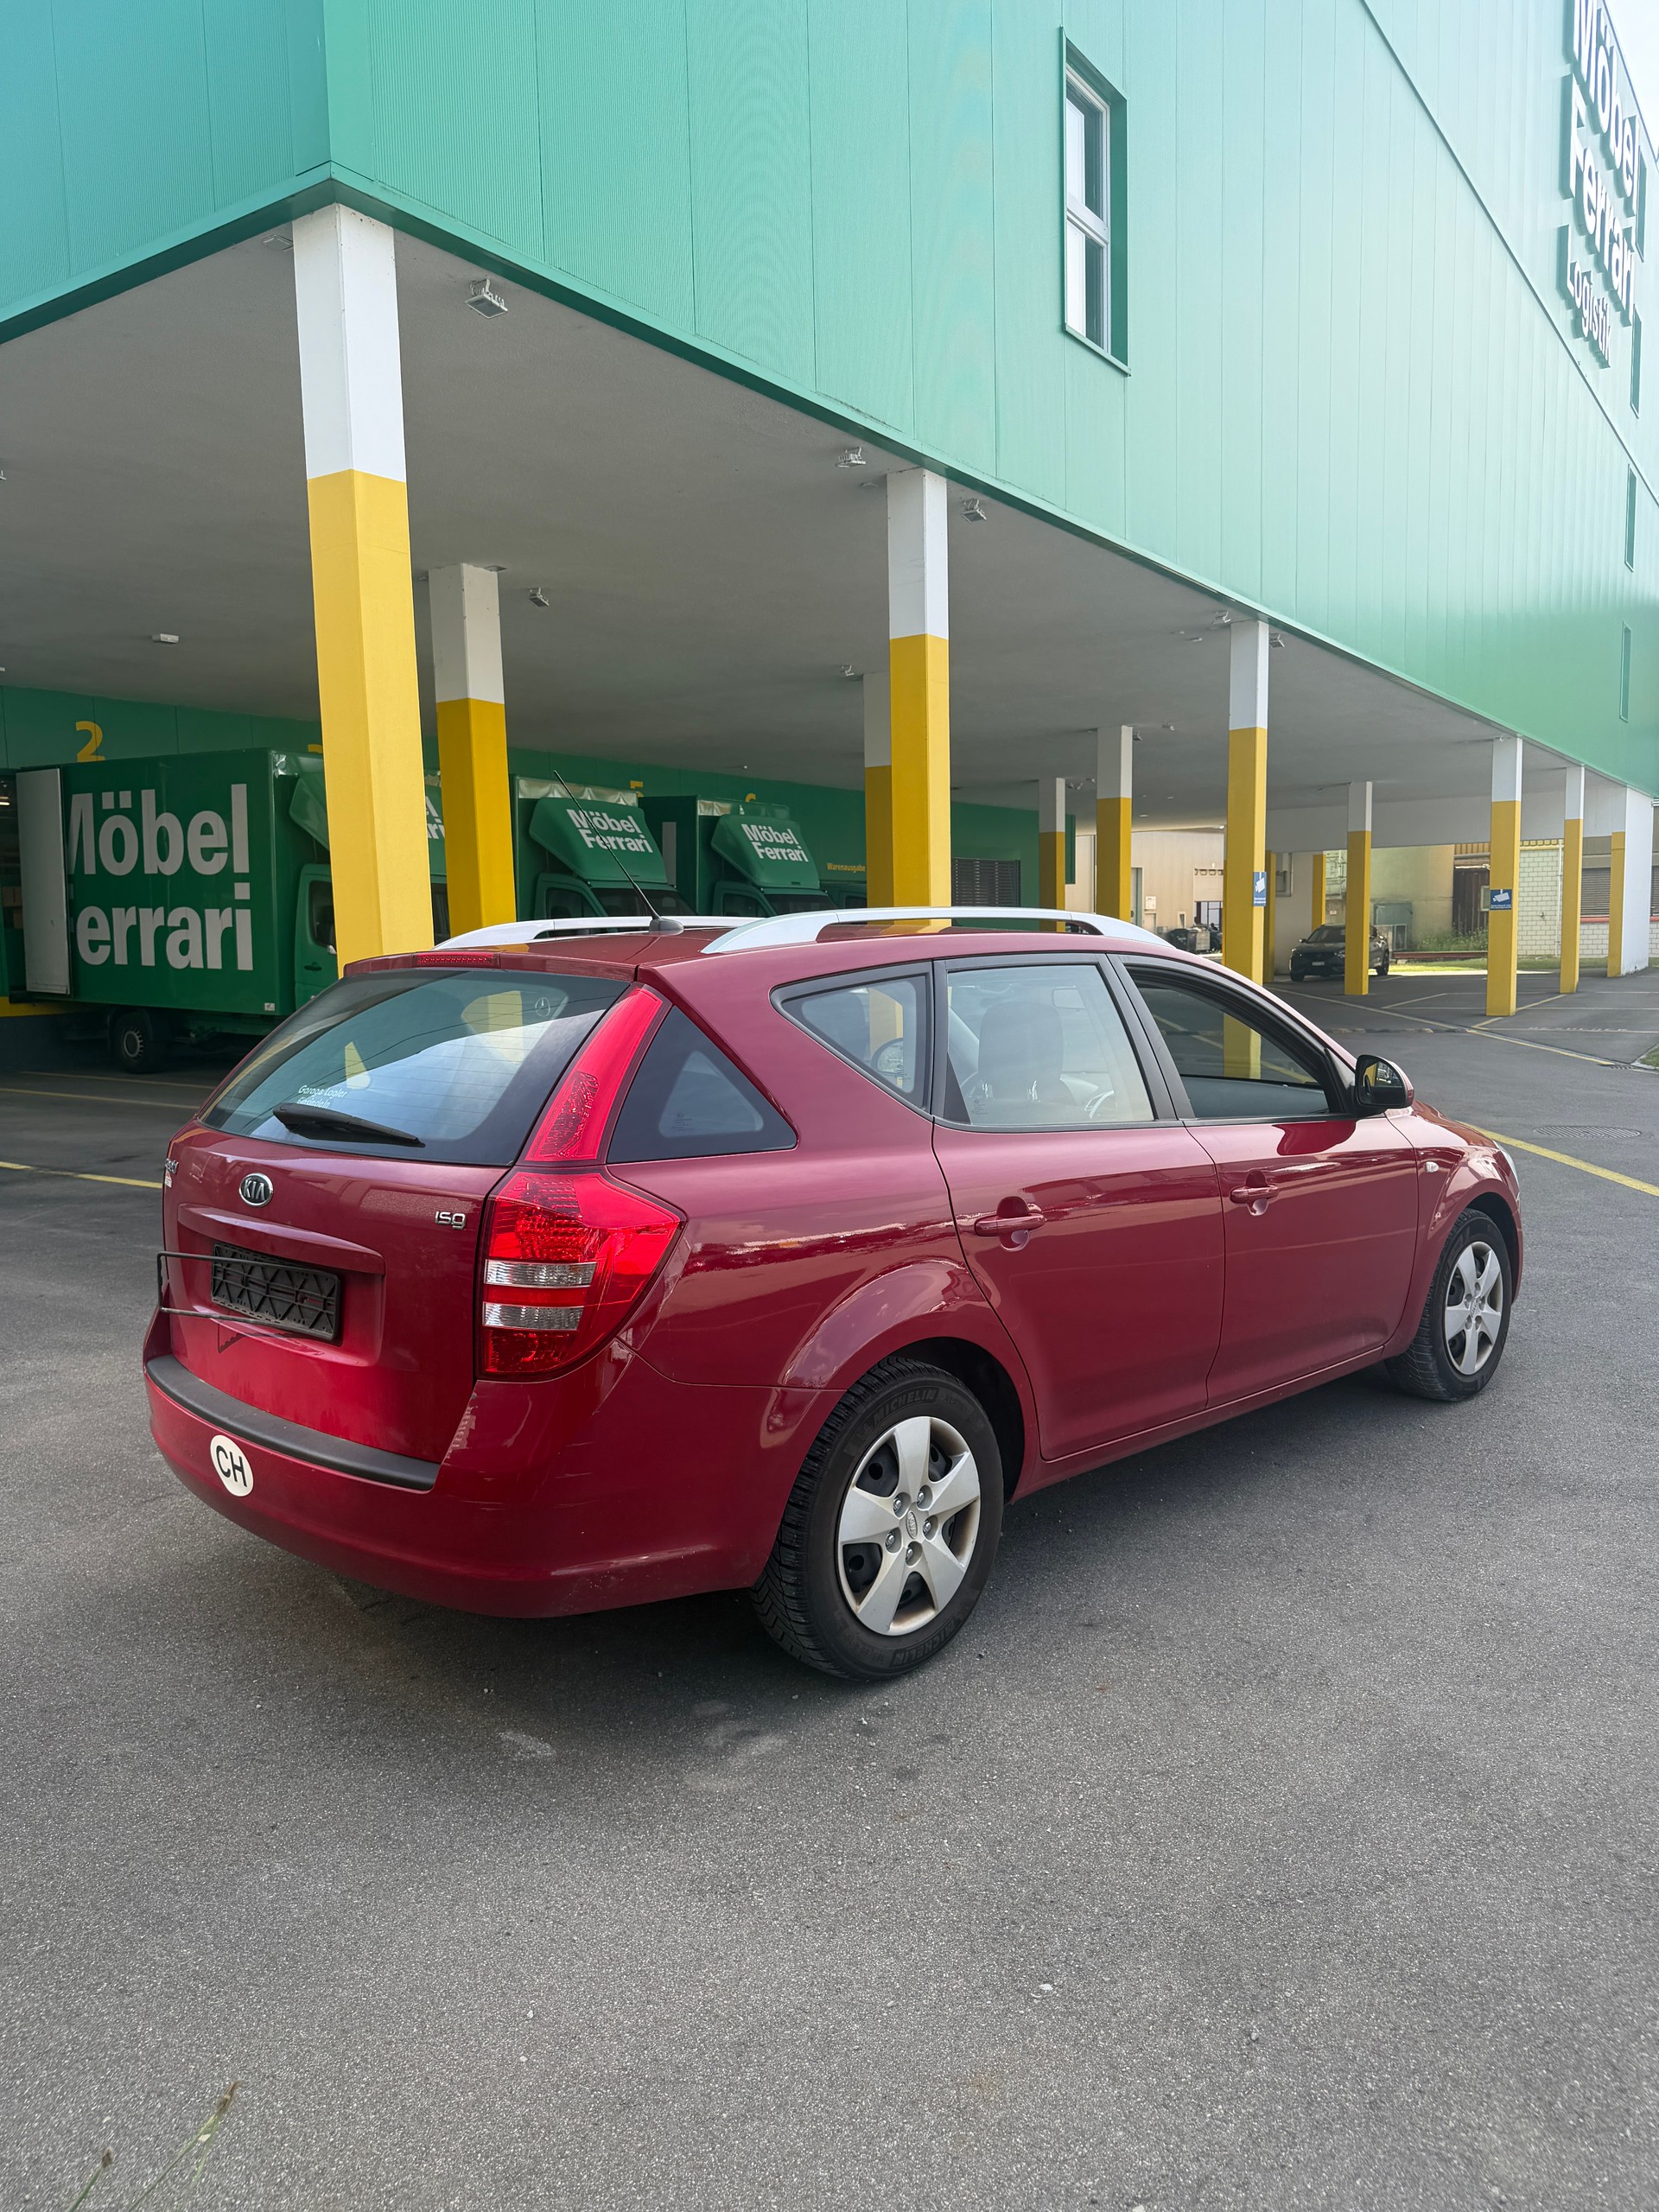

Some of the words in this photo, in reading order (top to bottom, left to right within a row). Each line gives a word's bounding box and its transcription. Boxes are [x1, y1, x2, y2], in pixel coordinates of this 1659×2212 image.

[1567, 224, 1611, 367] Logistik
[75, 721, 105, 762] 2
[566, 809, 642, 834] Möbel
[741, 823, 799, 845] Möbel
[578, 829, 653, 854] Ferrari
[751, 842, 809, 862] Ferrari
[76, 881, 254, 971] errari
[872, 1389, 937, 1424] MICHELIN
[215, 1445, 248, 1487] CH
